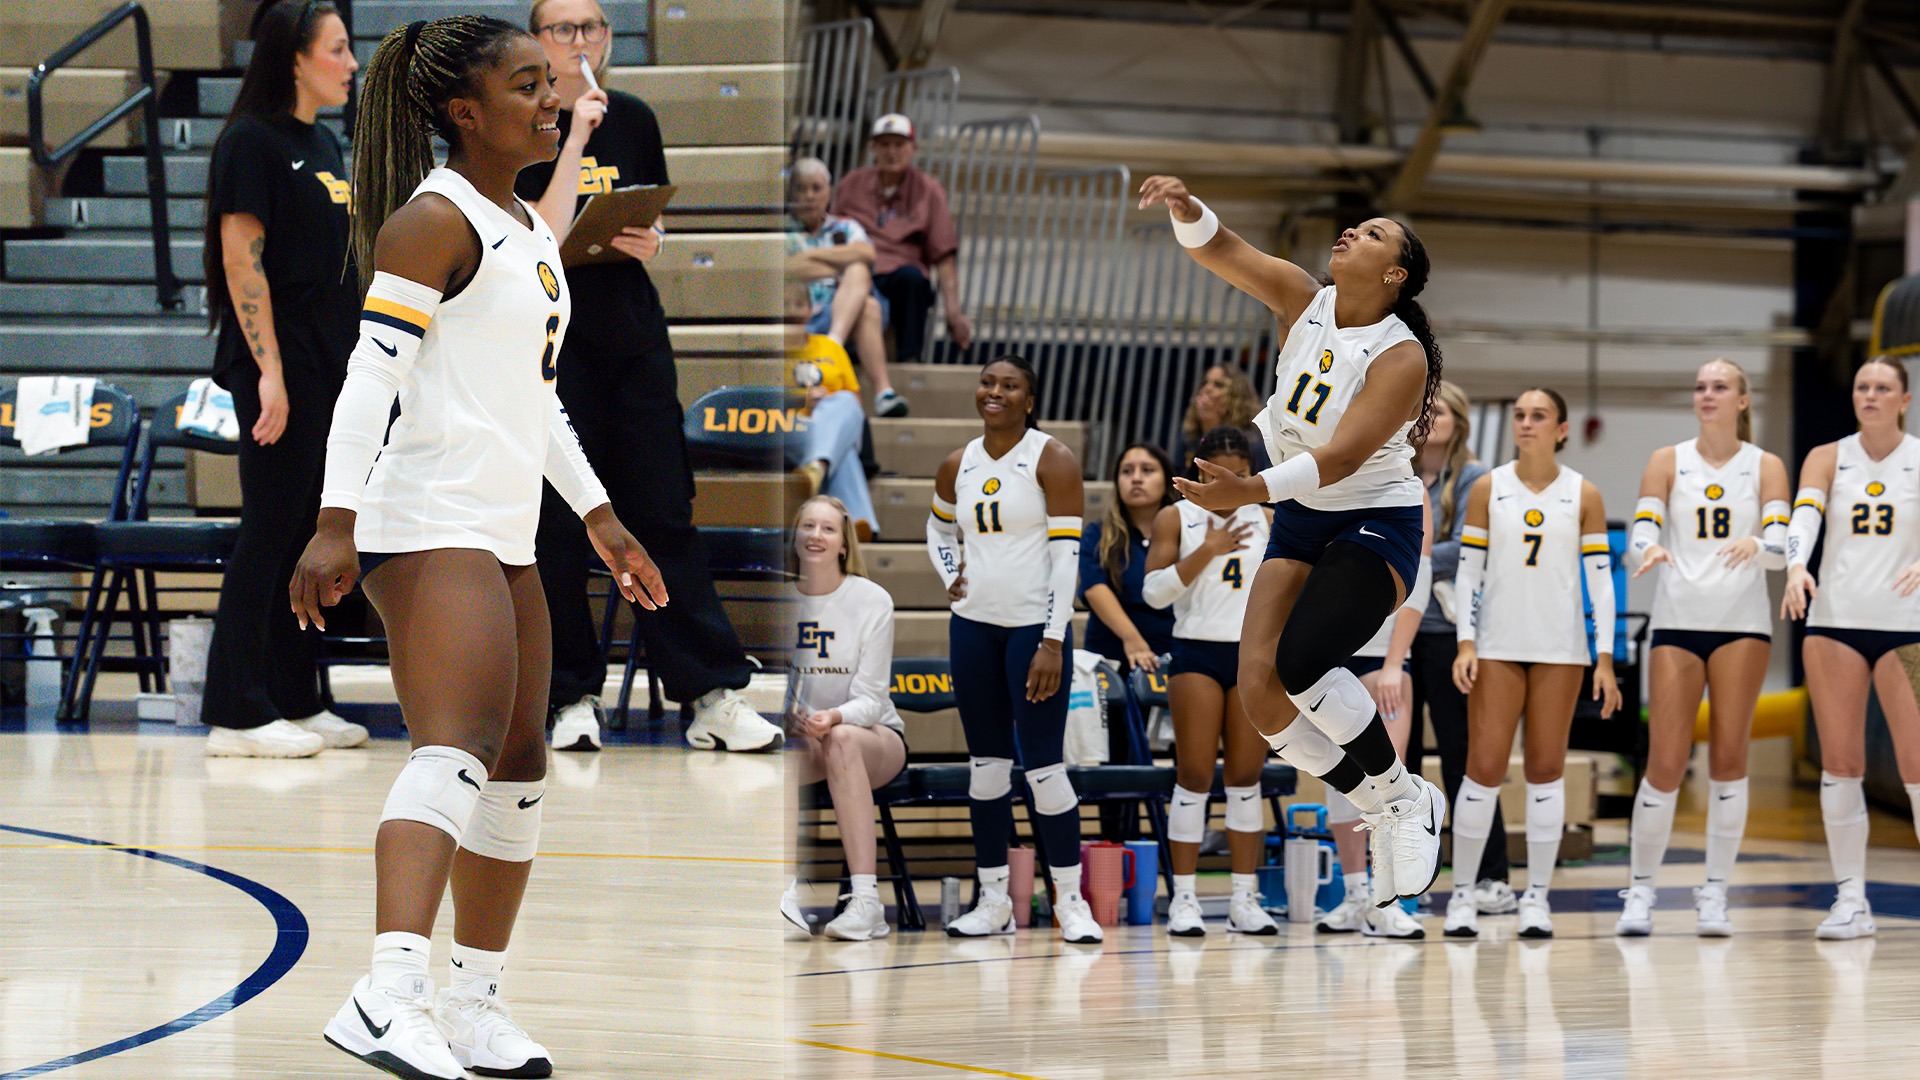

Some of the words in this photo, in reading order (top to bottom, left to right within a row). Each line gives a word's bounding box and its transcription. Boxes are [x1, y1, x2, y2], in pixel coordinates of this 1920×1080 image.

[1286, 371, 1333, 427] 17
[974, 500, 1003, 534] 11
[1695, 506, 1731, 540] 18
[1852, 502, 1895, 537] 23
[938, 545, 958, 575] EAST
[1523, 533, 1544, 568] 7
[1221, 555, 1244, 591] 4
[795, 620, 836, 660] ET
[786, 660, 852, 675] VLLEYBALL
[889, 673, 955, 695] ION
